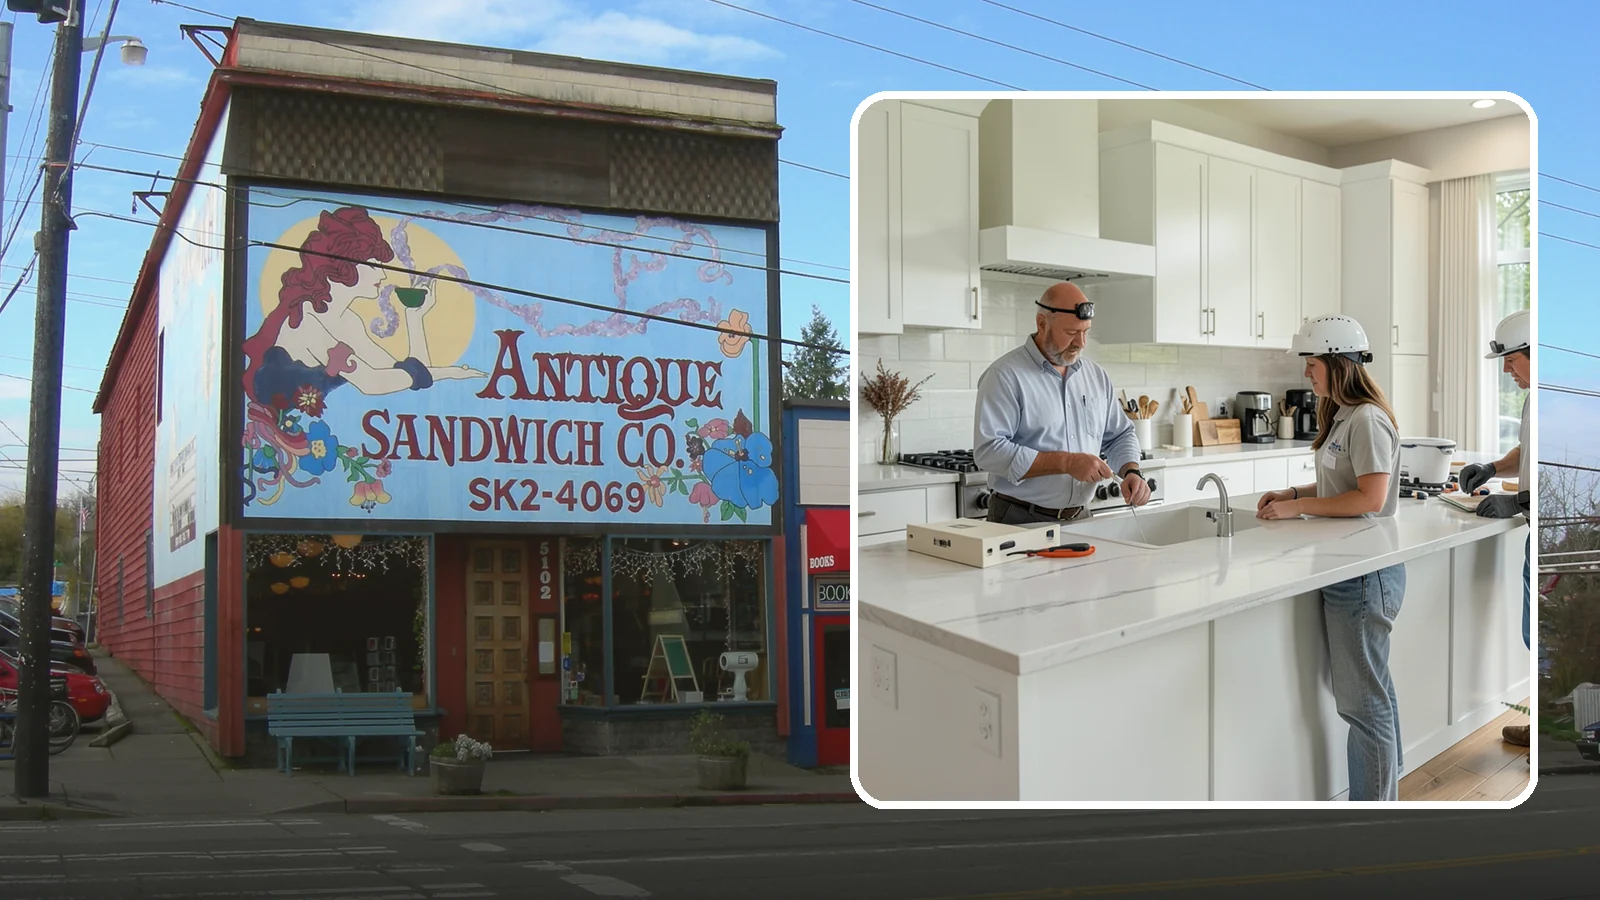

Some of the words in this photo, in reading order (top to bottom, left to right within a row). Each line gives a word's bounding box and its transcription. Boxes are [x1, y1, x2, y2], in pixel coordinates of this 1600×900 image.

[476, 329, 723, 420] ANTIQUE
[362, 409, 604, 467] SANDWICH
[617, 422, 685, 469] CO.
[469, 477, 646, 513] SK2-4069
[540, 542, 552, 599] 5102
[809, 555, 835, 569] BOOKS
